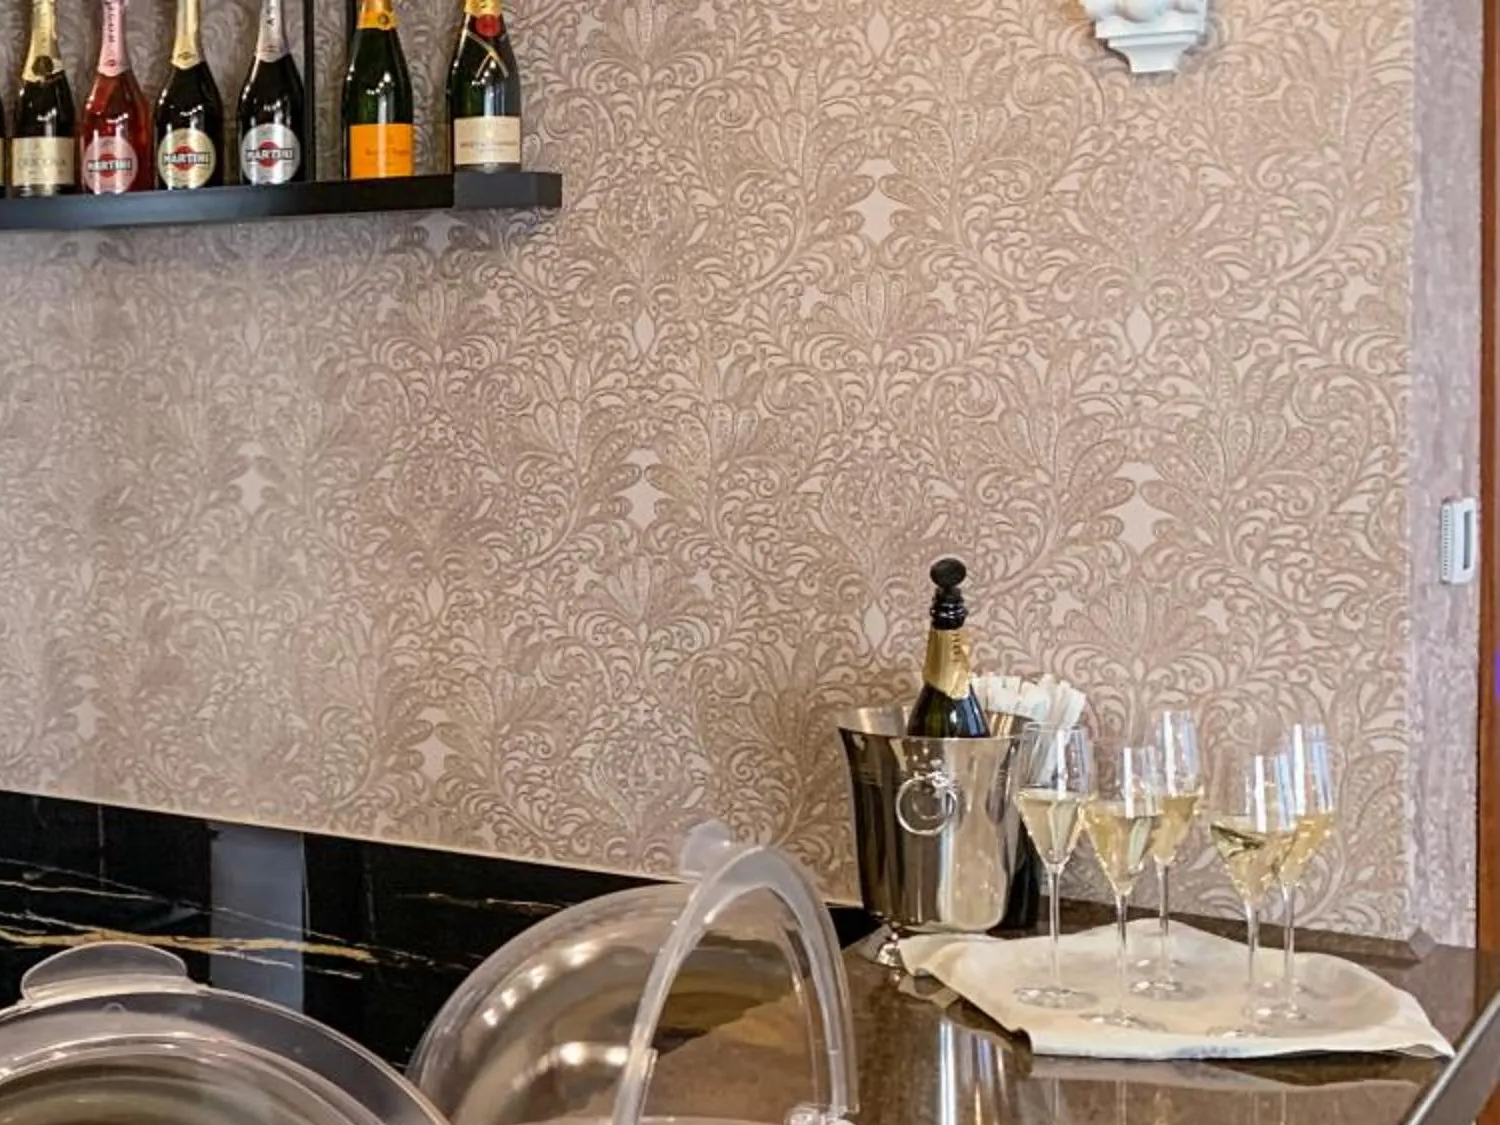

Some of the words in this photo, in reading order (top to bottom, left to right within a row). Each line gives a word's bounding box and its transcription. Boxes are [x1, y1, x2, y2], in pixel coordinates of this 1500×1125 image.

[162, 152, 211, 165] MARTINI
[245, 149, 294, 161] MARTINI
[86, 160, 133, 172] MARTINI
